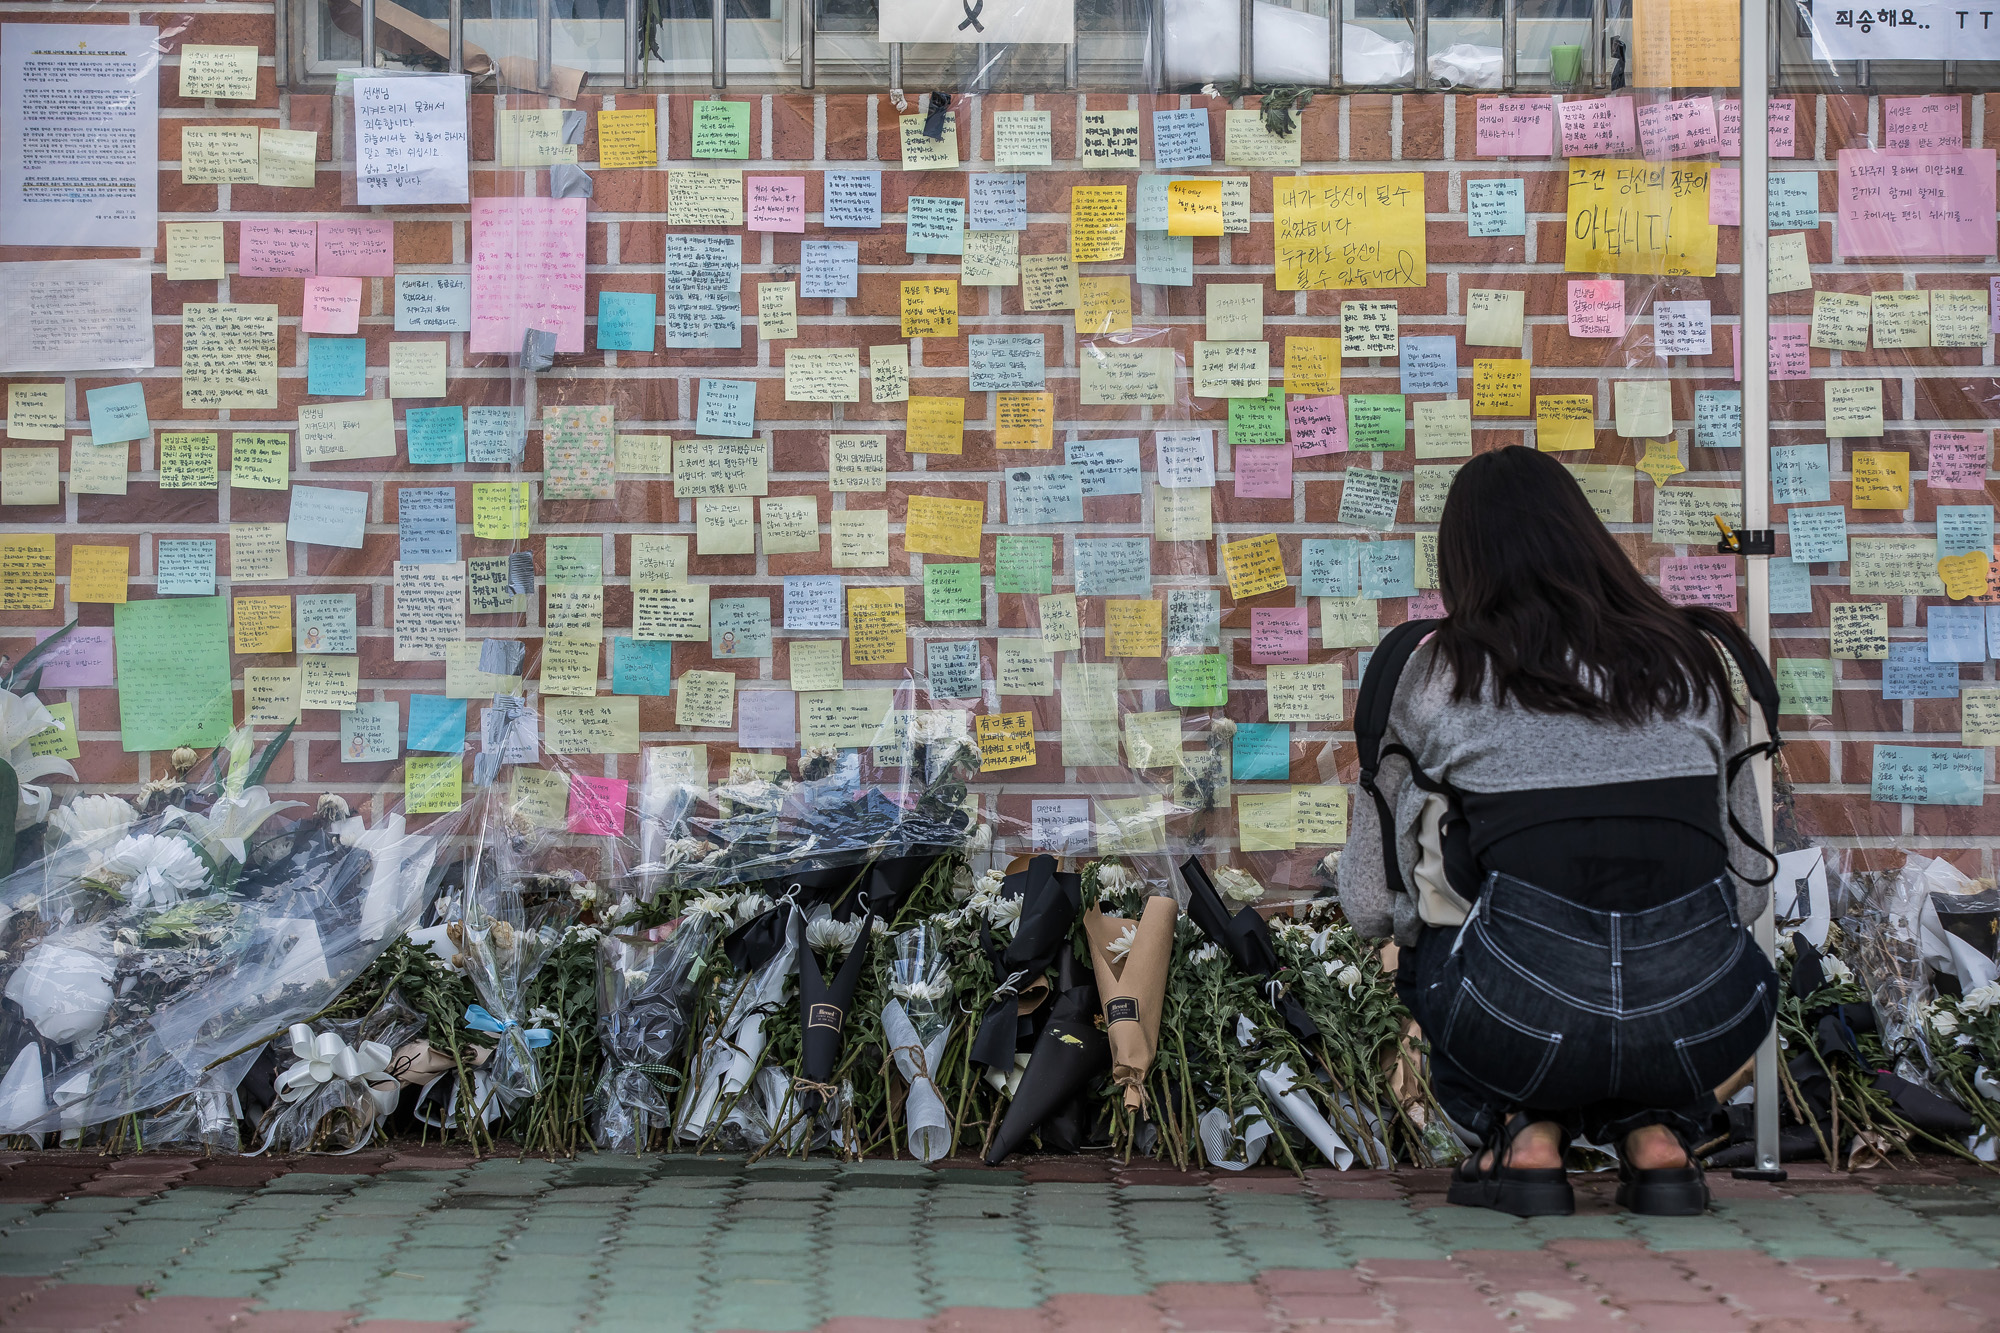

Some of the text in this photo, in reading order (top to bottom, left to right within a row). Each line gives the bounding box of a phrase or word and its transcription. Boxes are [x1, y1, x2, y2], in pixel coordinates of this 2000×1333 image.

[1835, 8, 1931, 34] 죄송해요..
[362, 86, 390, 103] 선생님
[364, 118, 415, 132] 죄송합니다.
[364, 131, 406, 145] 하늘에서는
[1567, 167, 1708, 198] 그건 당신의 잘못이
[1282, 189, 1316, 208] 내가
[1324, 185, 1367, 208] 당신이
[1282, 240, 1380, 271] 누구라도 당신이
[1314, 269, 1332, 289] 수
[1338, 266, 1402, 287] 있습니다
[1572, 299, 1596, 313] 잘못이
[638, 555, 676, 569] 행복하시길
